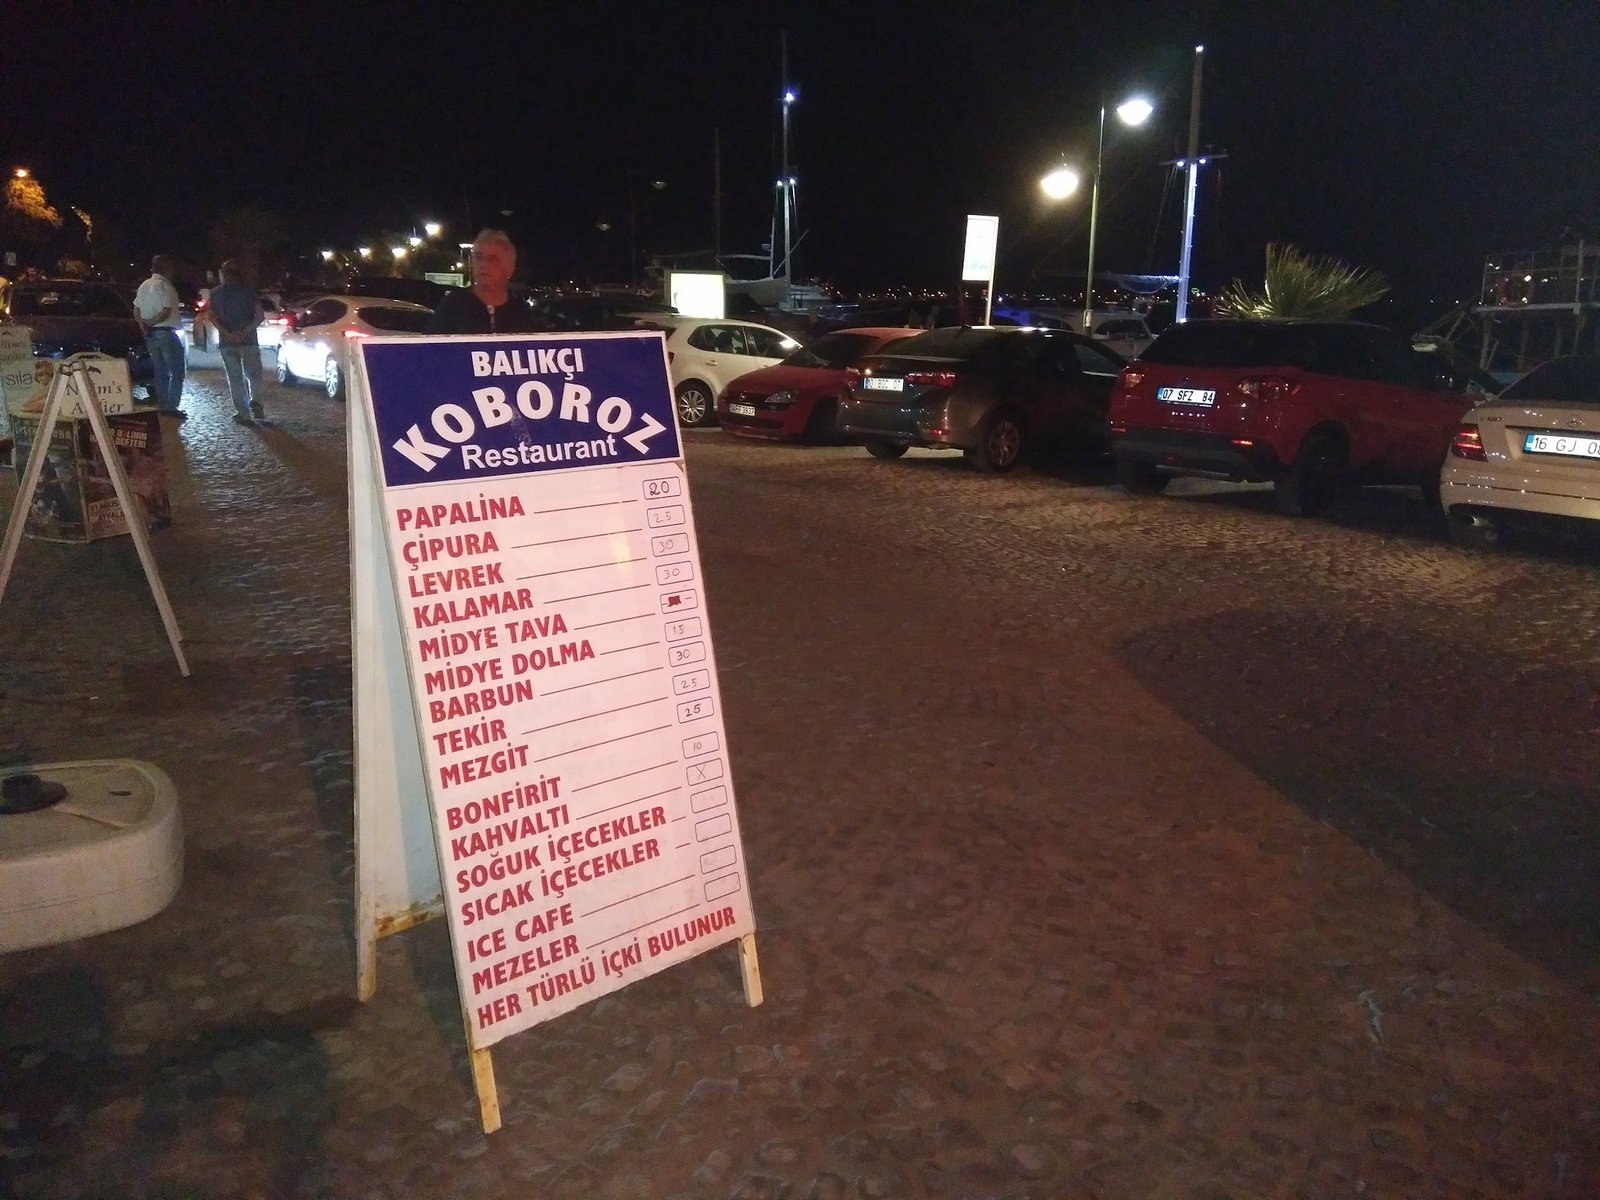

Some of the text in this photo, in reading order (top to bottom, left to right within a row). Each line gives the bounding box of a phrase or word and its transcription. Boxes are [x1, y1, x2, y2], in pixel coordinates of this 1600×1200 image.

[471, 348, 583, 380] BALIKÇI
[1162, 389, 1213, 402] 07 SFZ 84
[392, 380, 667, 472] KOBOROZ
[1534, 436, 1548, 450] 16
[1556, 438, 1577, 452] GJ
[461, 433, 618, 470] Restaurant
[648, 480, 670, 496] 20
[396, 493, 525, 531] PAPALİNA
[654, 511, 672, 523] 25
[402, 531, 499, 571] ÇİPURA
[658, 539, 674, 553] 30
[408, 562, 504, 598] LEVREK
[664, 568, 680, 580] 30
[413, 588, 534, 628] KALAMAR
[419, 614, 568, 662] MİDYE TAVA
[672, 624, 684, 635] 15
[425, 639, 595, 695] MİDYE DOLMA
[676, 648, 690, 661] 30
[429, 680, 533, 724] BARBUN
[681, 678, 697, 689] 25
[684, 703, 702, 717] 25
[433, 716, 507, 756] TEKİR
[693, 741, 702, 752] 10
[440, 742, 529, 789] MEZGİT
[446, 774, 561, 830] BONFİRİT
[451, 805, 570, 861] KAHVALTI
[456, 806, 667, 893] SOĞUK İÇECEKLER
[460, 840, 660, 925] SICAK İÇECEKLER
[467, 903, 574, 962] ICE CAFE
[472, 934, 580, 994] MEZELER
[478, 906, 736, 1030] HER TÜRLÜ İÇKİ BULUNUR
